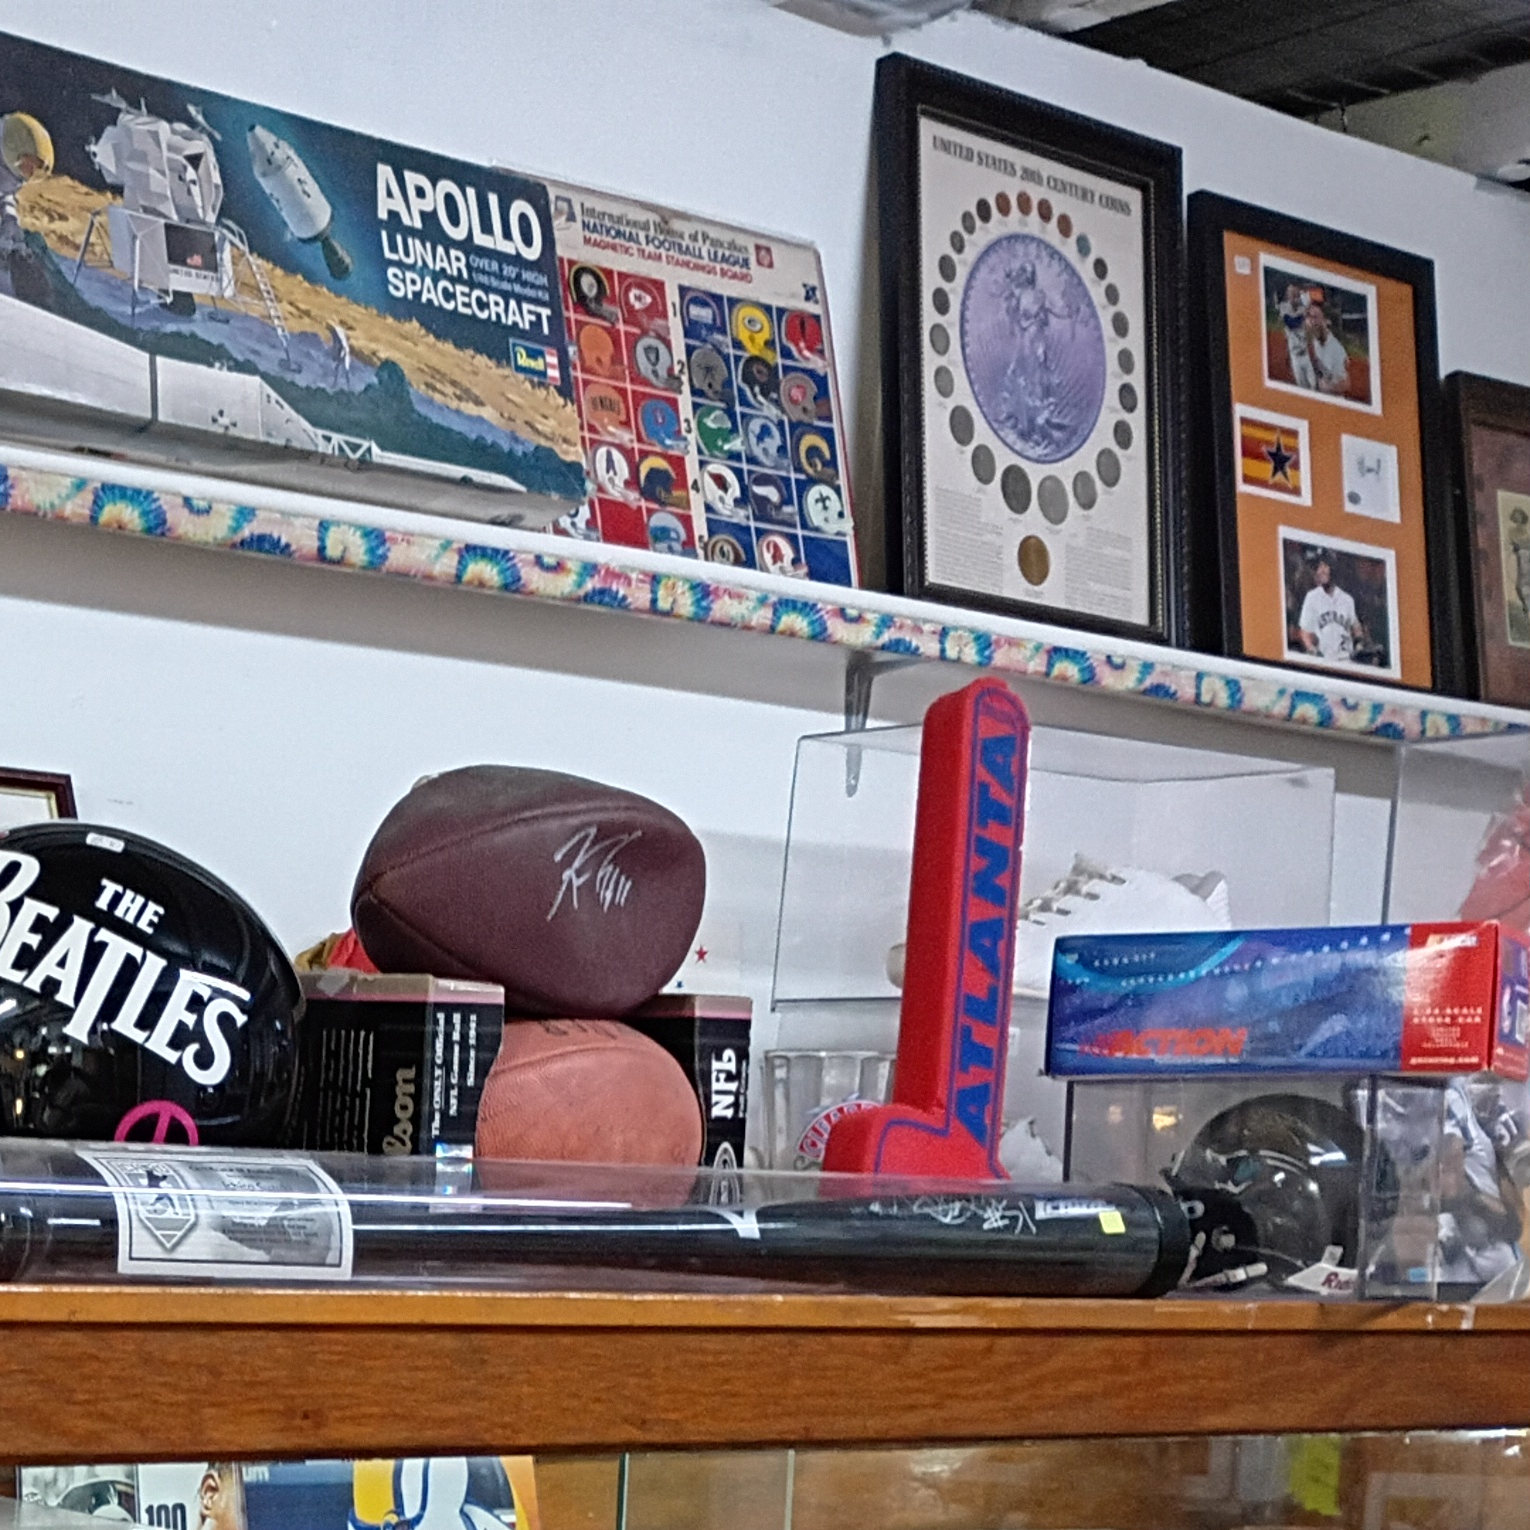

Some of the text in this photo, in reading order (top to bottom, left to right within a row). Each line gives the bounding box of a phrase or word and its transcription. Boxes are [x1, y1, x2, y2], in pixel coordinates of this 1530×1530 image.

[932, 134, 974, 163] UNITED
[976, 150, 1017, 178] STATES
[1047, 175, 1096, 205] CENTURY
[377, 163, 542, 261] APOLLO
[580, 202, 650, 232] International
[381, 229, 468, 280] LUNAR
[470, 254, 499, 271] OVER
[521, 269, 548, 287] HIGH
[582, 219, 751, 270] NATIONAL FOOTBALL LEAGUE
[637, 247, 663, 265] TEAM
[387, 266, 551, 335] SPACECRAFT
[676, 359, 686, 375] 2
[683, 418, 692, 434] 3
[690, 478, 700, 493] 4
[94, 877, 165, 935] THE
[955, 735, 1017, 1148] ATLANTA
[1106, 1028, 1248, 1058] ACTION
[433, 1065, 443, 1110] ONLY
[449, 1086, 458, 1117] NFL
[711, 1048, 739, 1120] NFL
[432, 1111, 441, 1139] The
